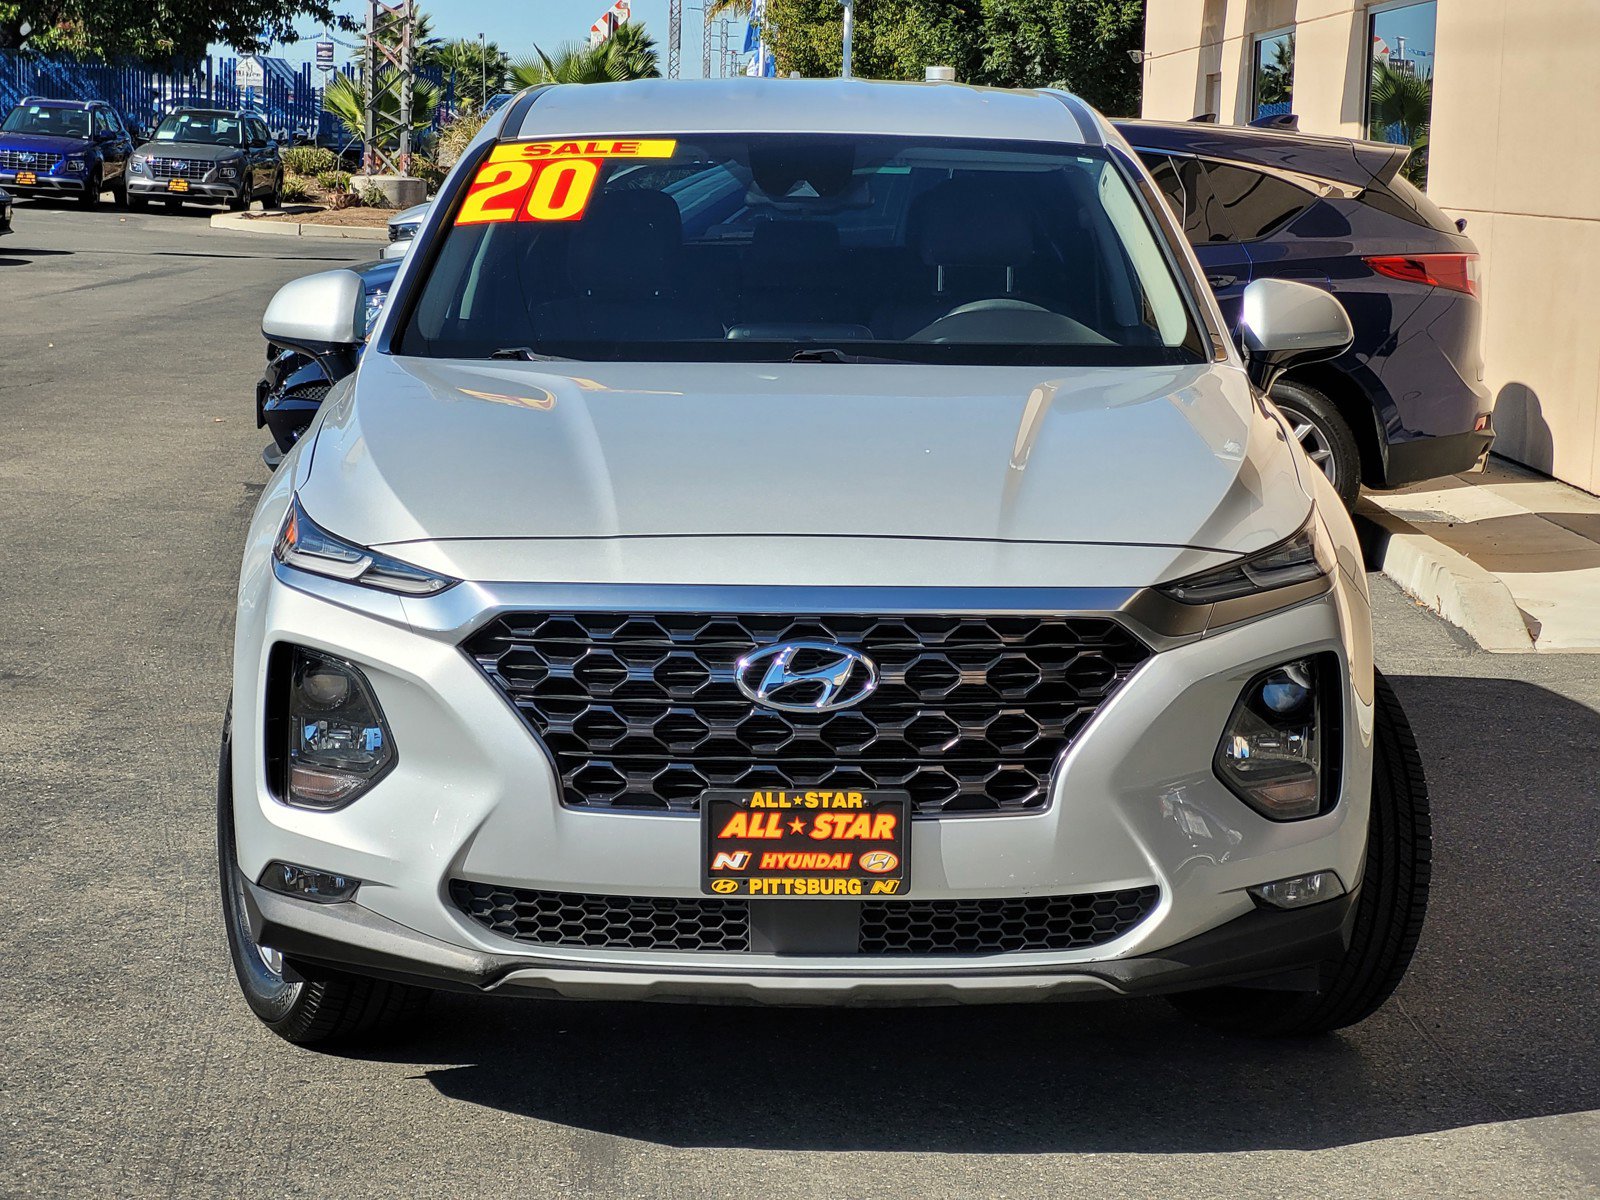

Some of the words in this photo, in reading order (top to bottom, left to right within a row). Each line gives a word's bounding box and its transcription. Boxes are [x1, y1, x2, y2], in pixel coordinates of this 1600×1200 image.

[522, 142, 642, 157] SALE
[456, 159, 597, 223] 20
[718, 812, 784, 839] ALL
[809, 812, 897, 840] STAR
[759, 852, 853, 870] HYUNDAI
[749, 879, 862, 895] PITTSBURG
